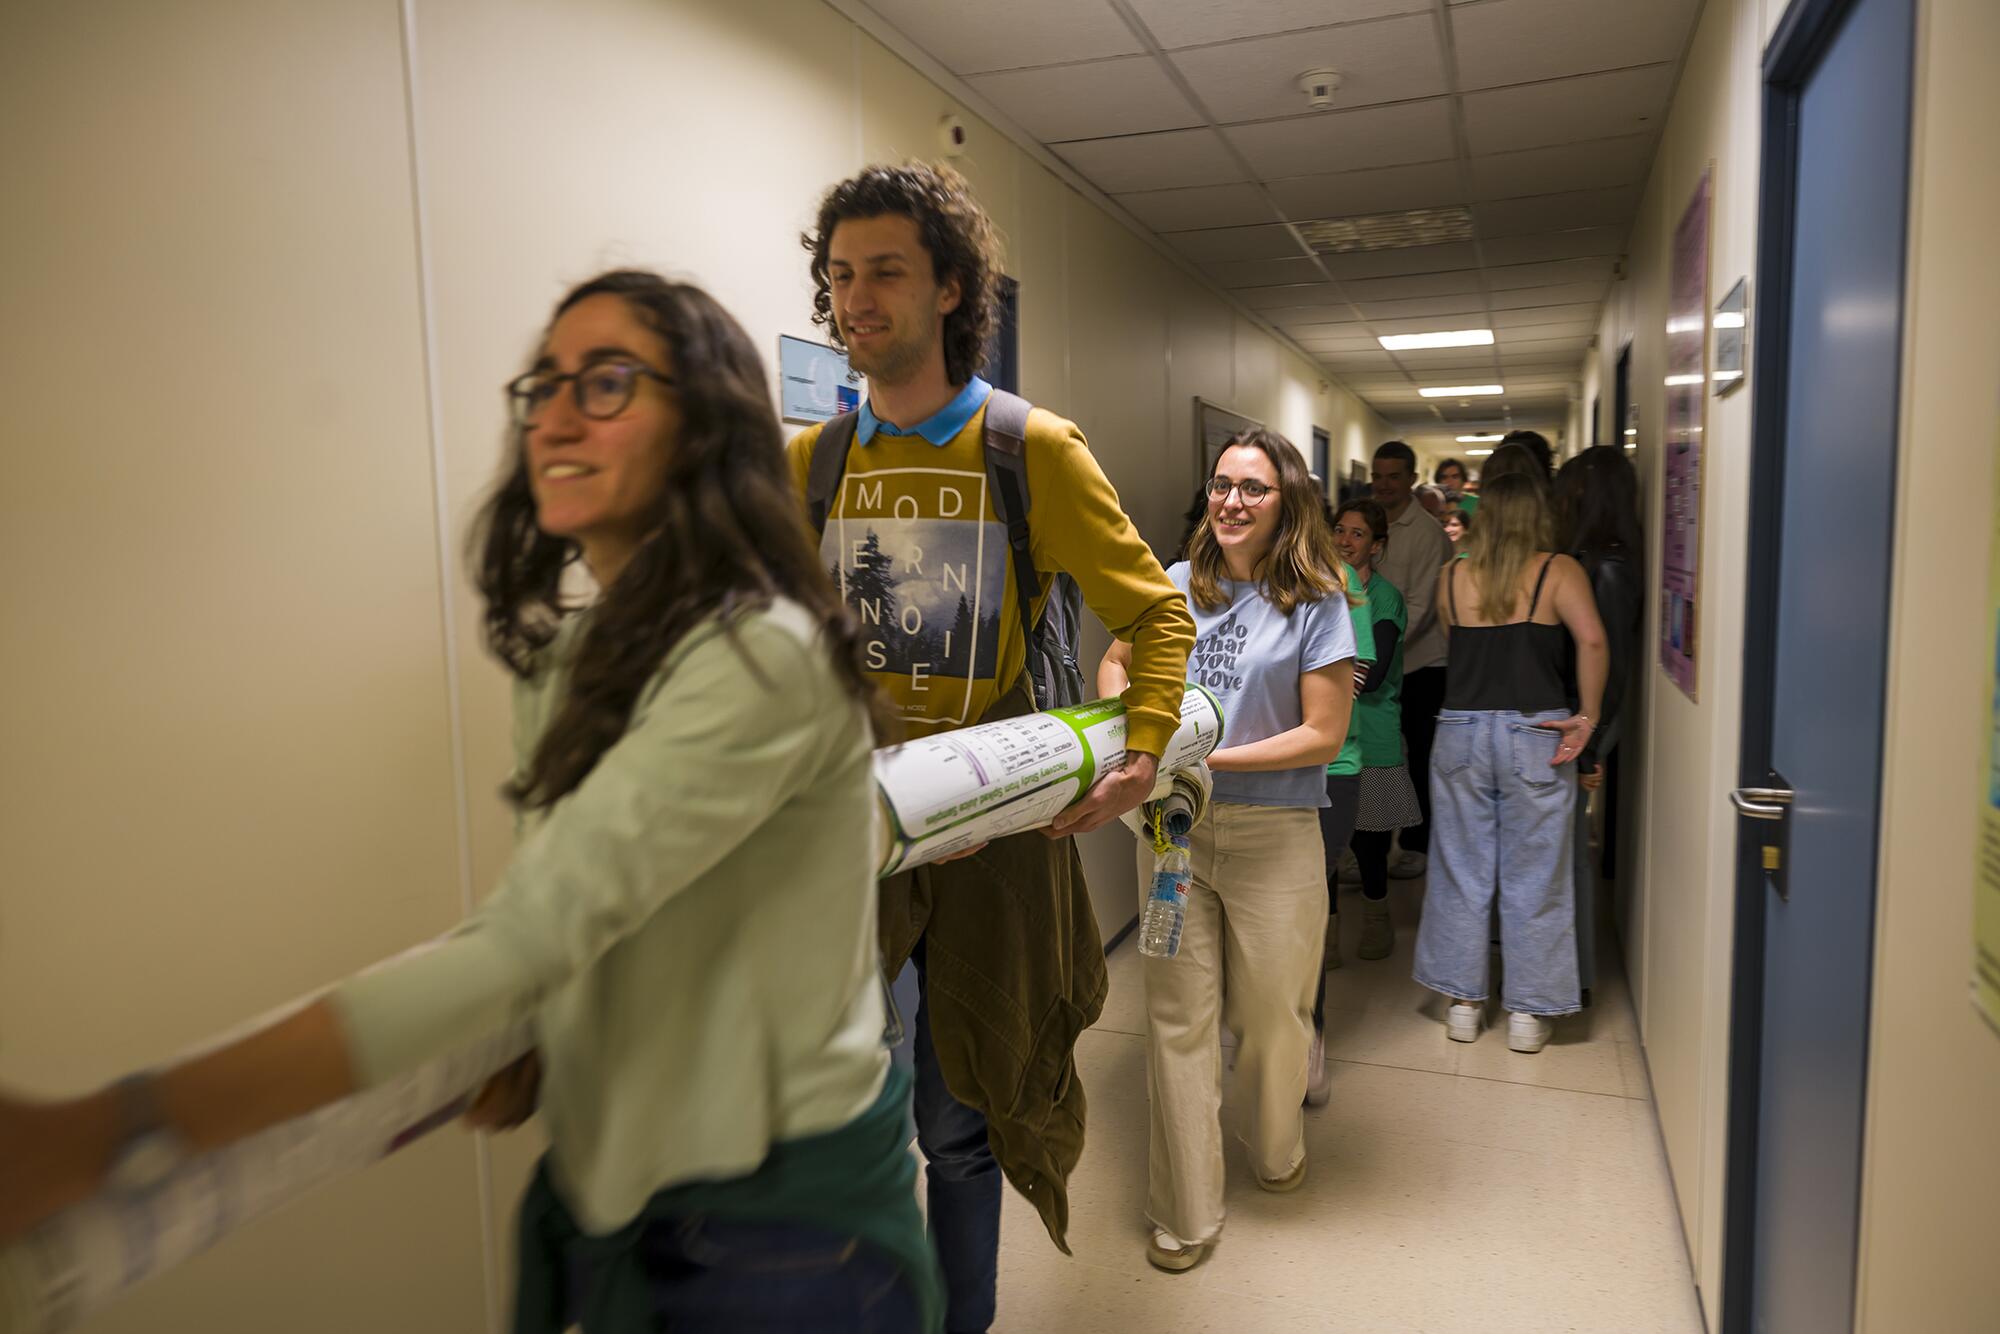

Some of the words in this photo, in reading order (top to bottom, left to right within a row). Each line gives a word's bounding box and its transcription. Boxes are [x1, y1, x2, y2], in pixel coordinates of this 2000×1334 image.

[1218, 613, 1248, 639] do
[1195, 652, 1237, 673] you
[1200, 669, 1242, 691] love
